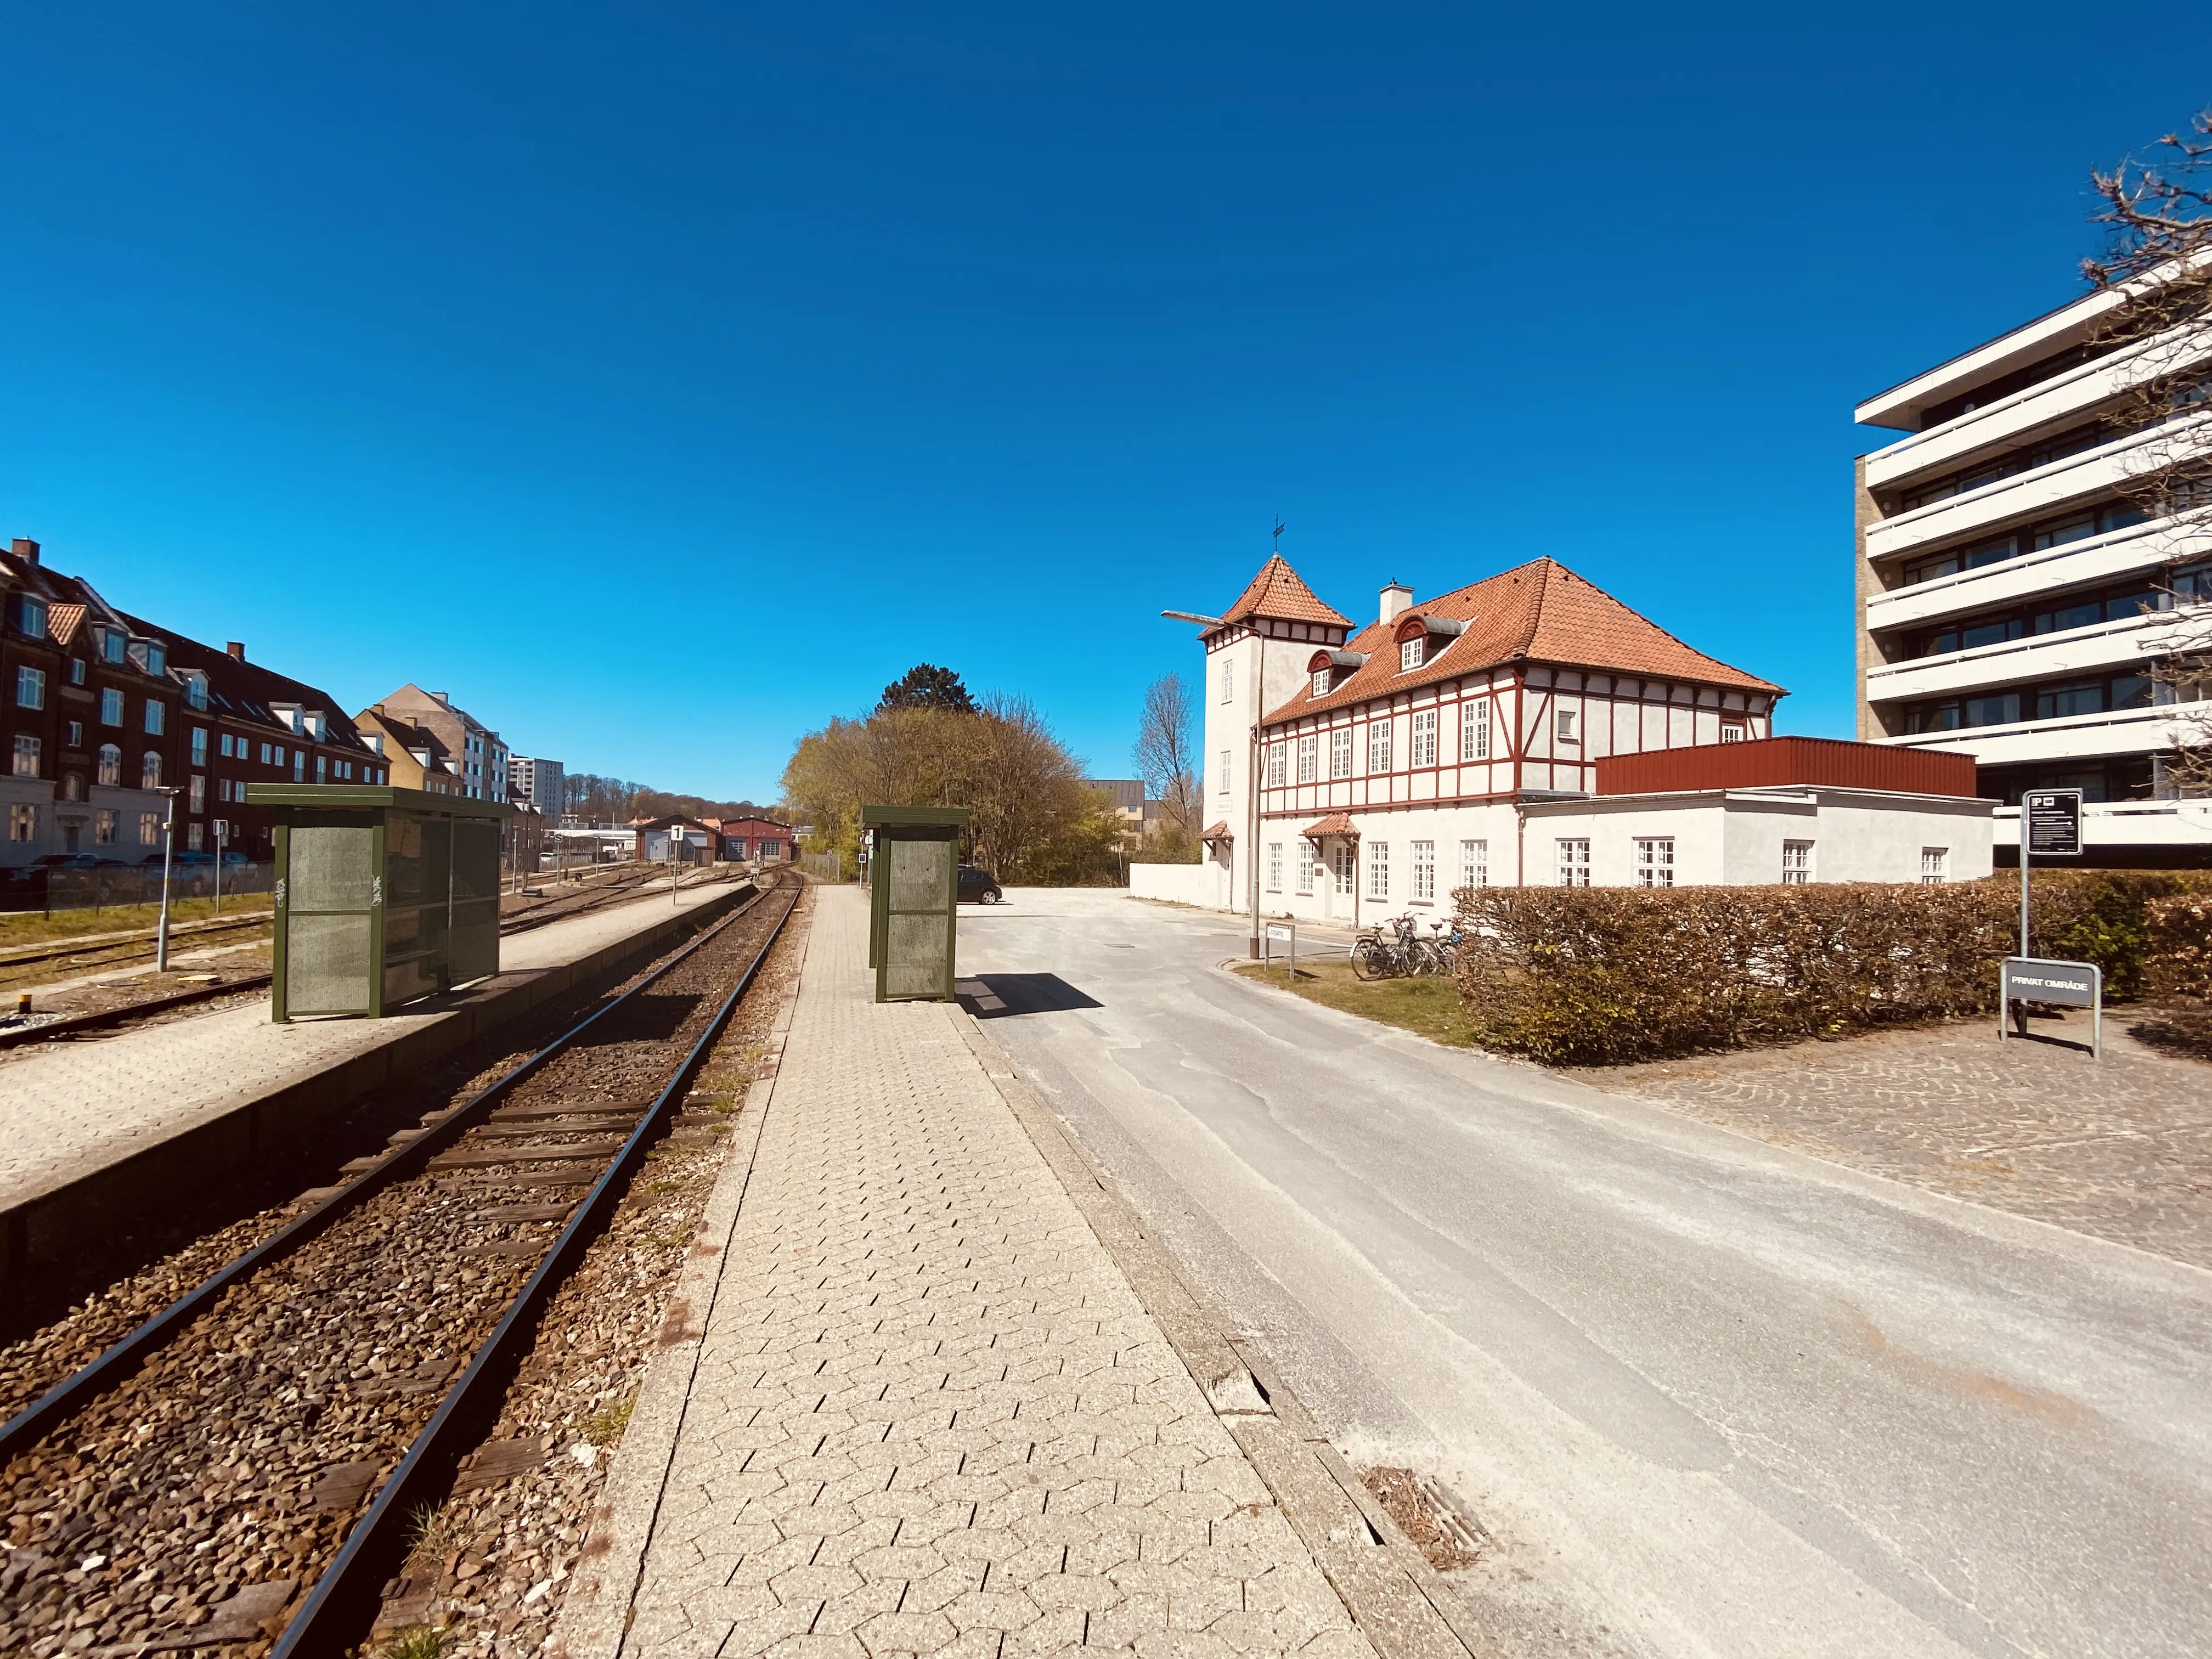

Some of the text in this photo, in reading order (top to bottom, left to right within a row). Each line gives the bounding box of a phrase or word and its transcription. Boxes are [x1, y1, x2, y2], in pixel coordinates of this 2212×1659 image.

[674, 827, 680, 838] 1
[2011, 975, 2088, 991] PRIVAT OMRÅDE
